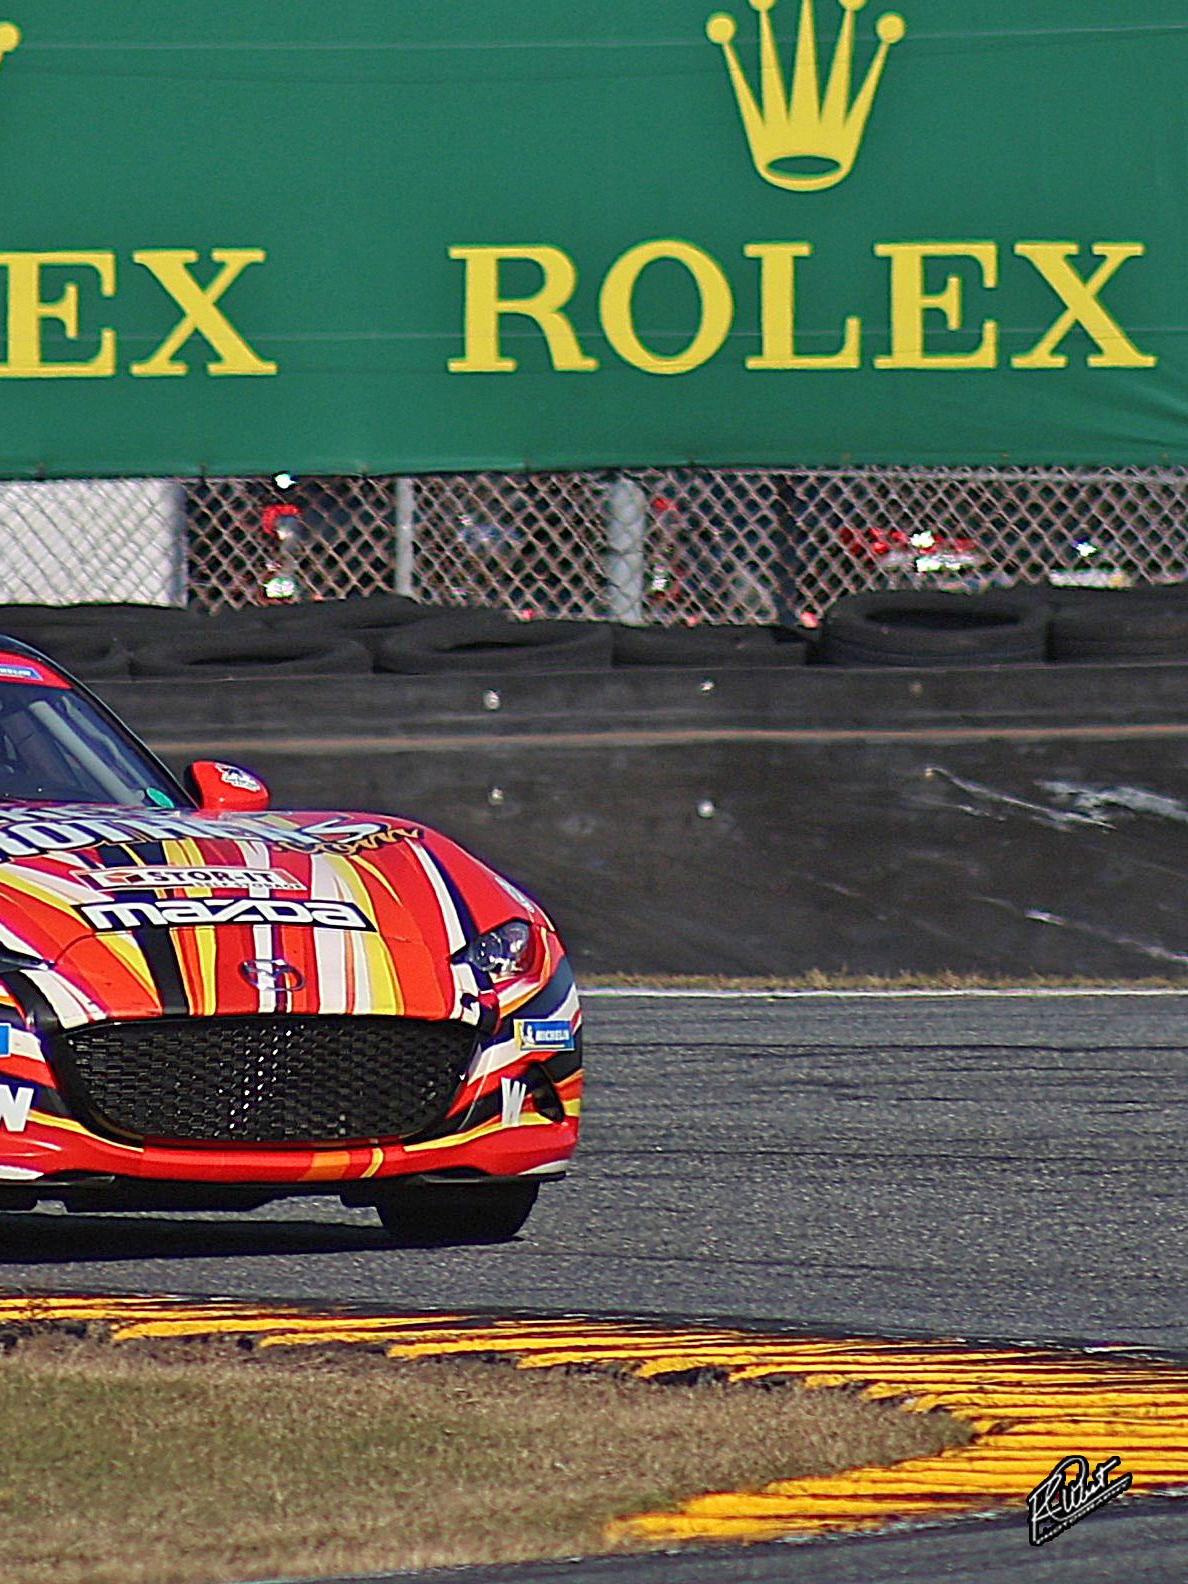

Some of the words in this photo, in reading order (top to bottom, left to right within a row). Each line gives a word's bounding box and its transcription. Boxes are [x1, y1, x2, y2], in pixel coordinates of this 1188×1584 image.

[447, 240, 1157, 374] ROLEX
[148, 870, 275, 883] STOR-IT
[501, 1077, 527, 1127] W
